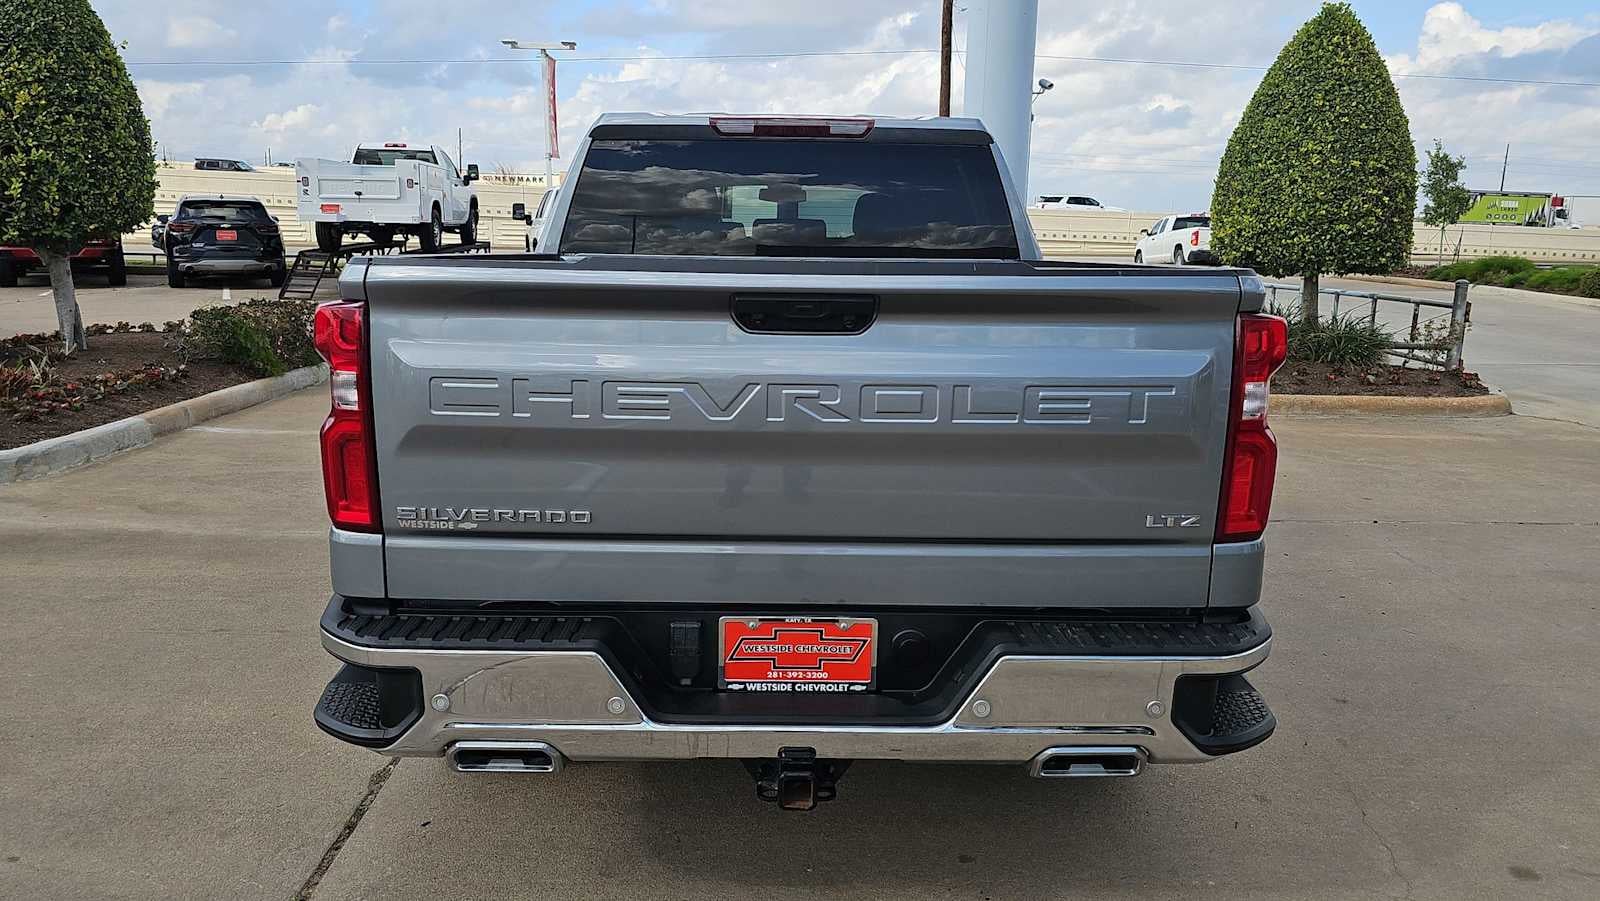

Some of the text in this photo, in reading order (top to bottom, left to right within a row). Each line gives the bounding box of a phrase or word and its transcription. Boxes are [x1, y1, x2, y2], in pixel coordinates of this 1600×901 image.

[495, 176, 544, 184] NEWMARK
[428, 376, 1177, 425] CHEVROLET
[396, 507, 593, 523] SILVERADO
[399, 520, 455, 529] WESTSIDE
[1146, 514, 1200, 527] LTZ
[742, 644, 854, 654] WESTSIDE CHEVROLET
[767, 671, 828, 679] 281-392-3200
[746, 683, 849, 692] WESTSIDE CHEVROLET
